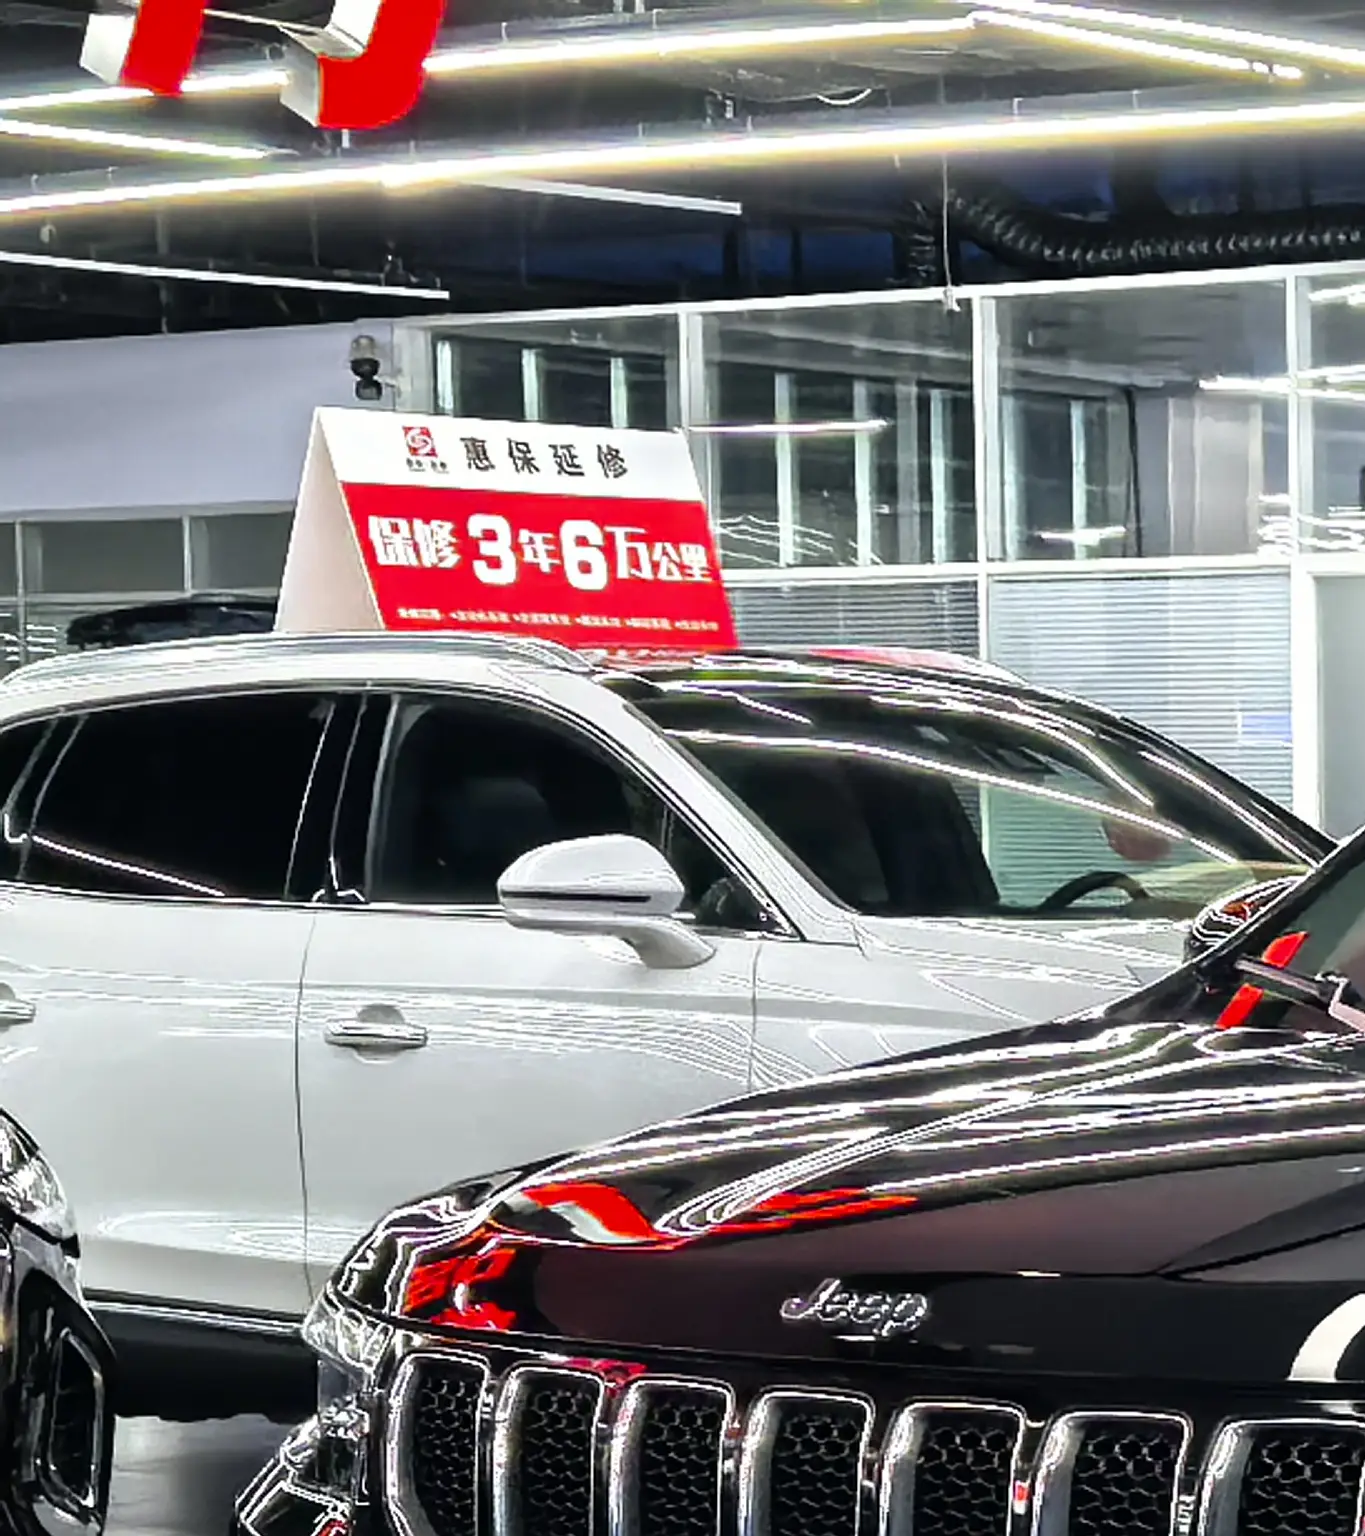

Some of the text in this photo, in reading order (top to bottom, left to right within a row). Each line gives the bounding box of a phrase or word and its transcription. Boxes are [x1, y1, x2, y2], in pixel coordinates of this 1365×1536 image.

[460, 436, 629, 479] 惠保延修
[367, 513, 714, 591] 保修3年6万公里
[779, 1277, 928, 1337] Jeep
